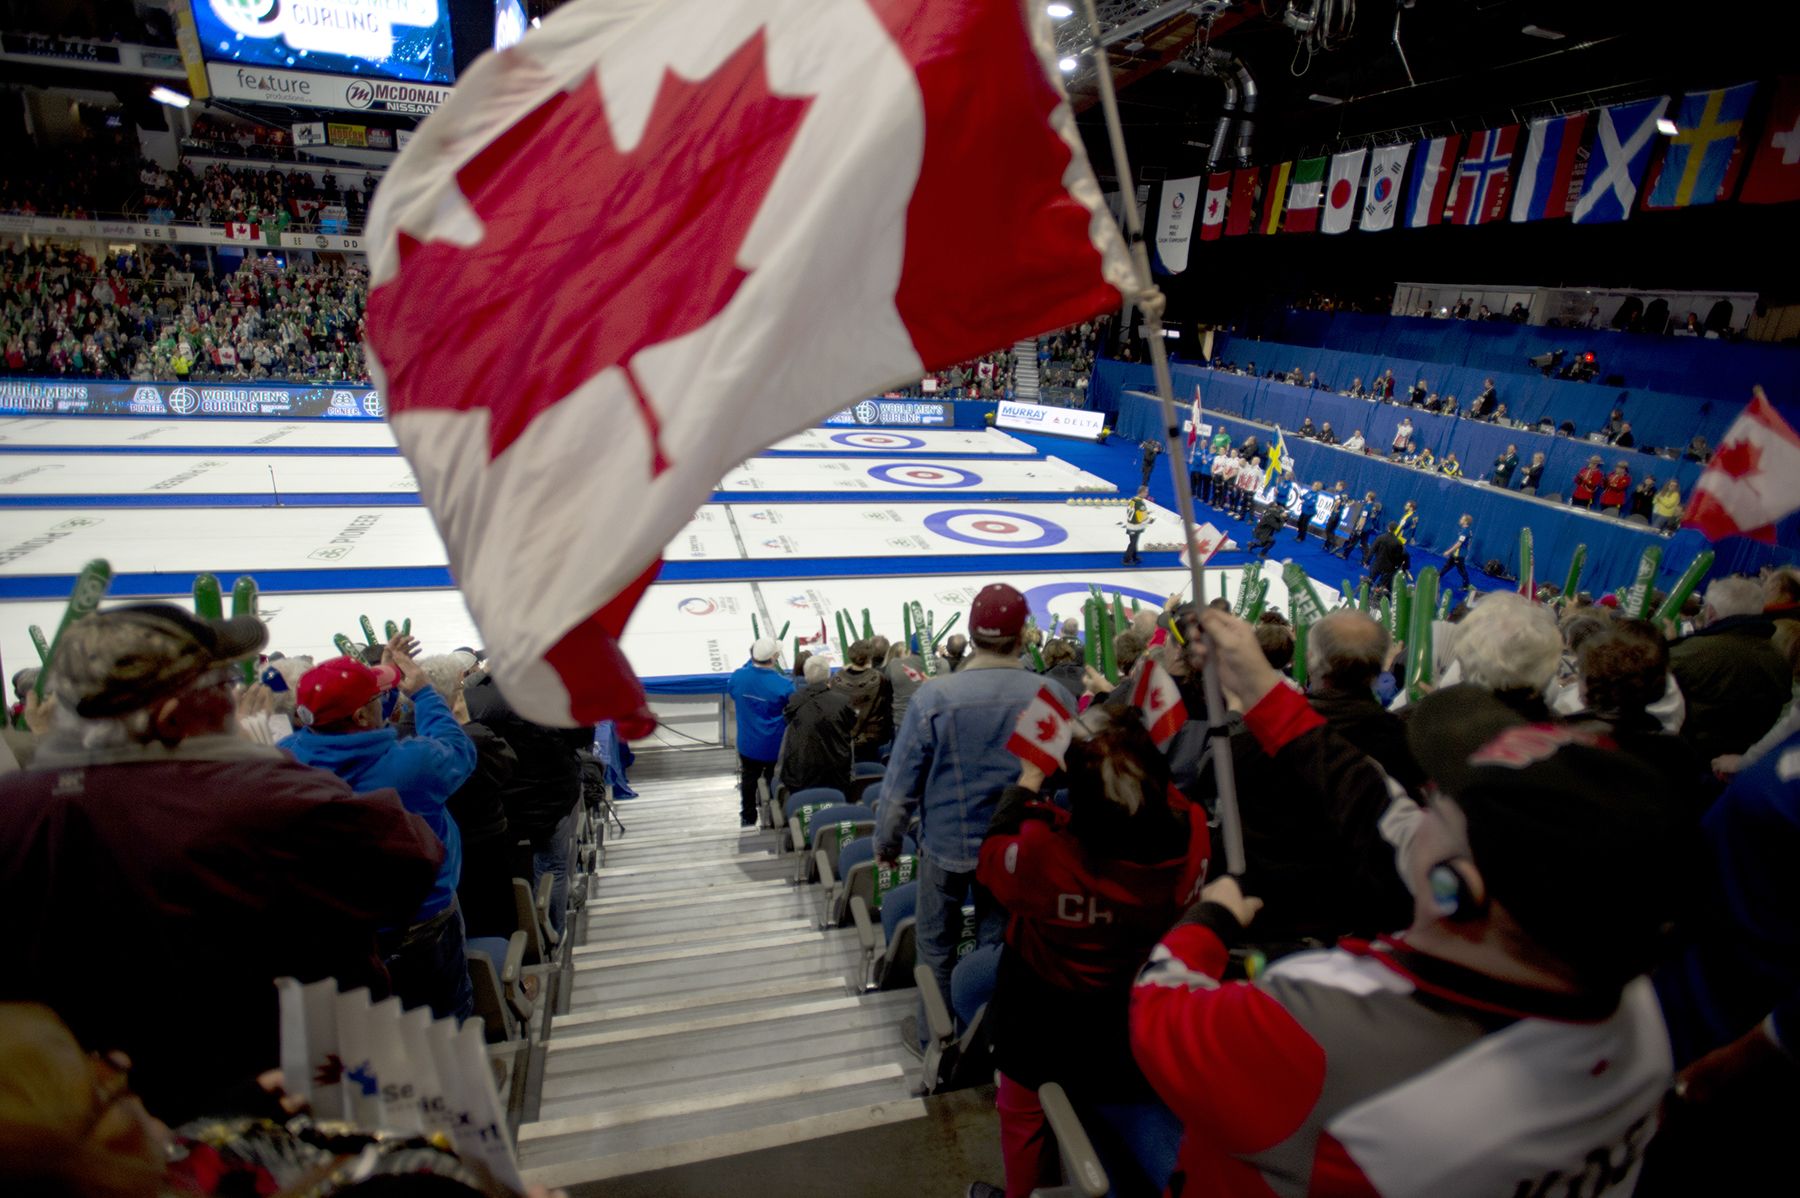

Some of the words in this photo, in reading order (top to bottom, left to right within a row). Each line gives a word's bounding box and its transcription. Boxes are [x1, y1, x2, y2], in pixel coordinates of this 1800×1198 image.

[293, 3, 379, 33] CURLING
[386, 102, 436, 114] NISSAN
[45, 387, 88, 400] MEN'S
[201, 390, 249, 402] WORLD
[250, 391, 290, 404] MEN'S
[130, 403, 166, 413] PIONEER
[201, 401, 258, 413] CURLING
[327, 407, 361, 416] PIONEER
[914, 404, 943, 415] MEN'S
[1002, 405, 1048, 420] MURRAY
[1063, 417, 1099, 428] DELTA
[329, 514, 384, 544] PIONEER
[707, 639, 724, 673] CORTEVA
[919, 628, 938, 674] PIONEER
